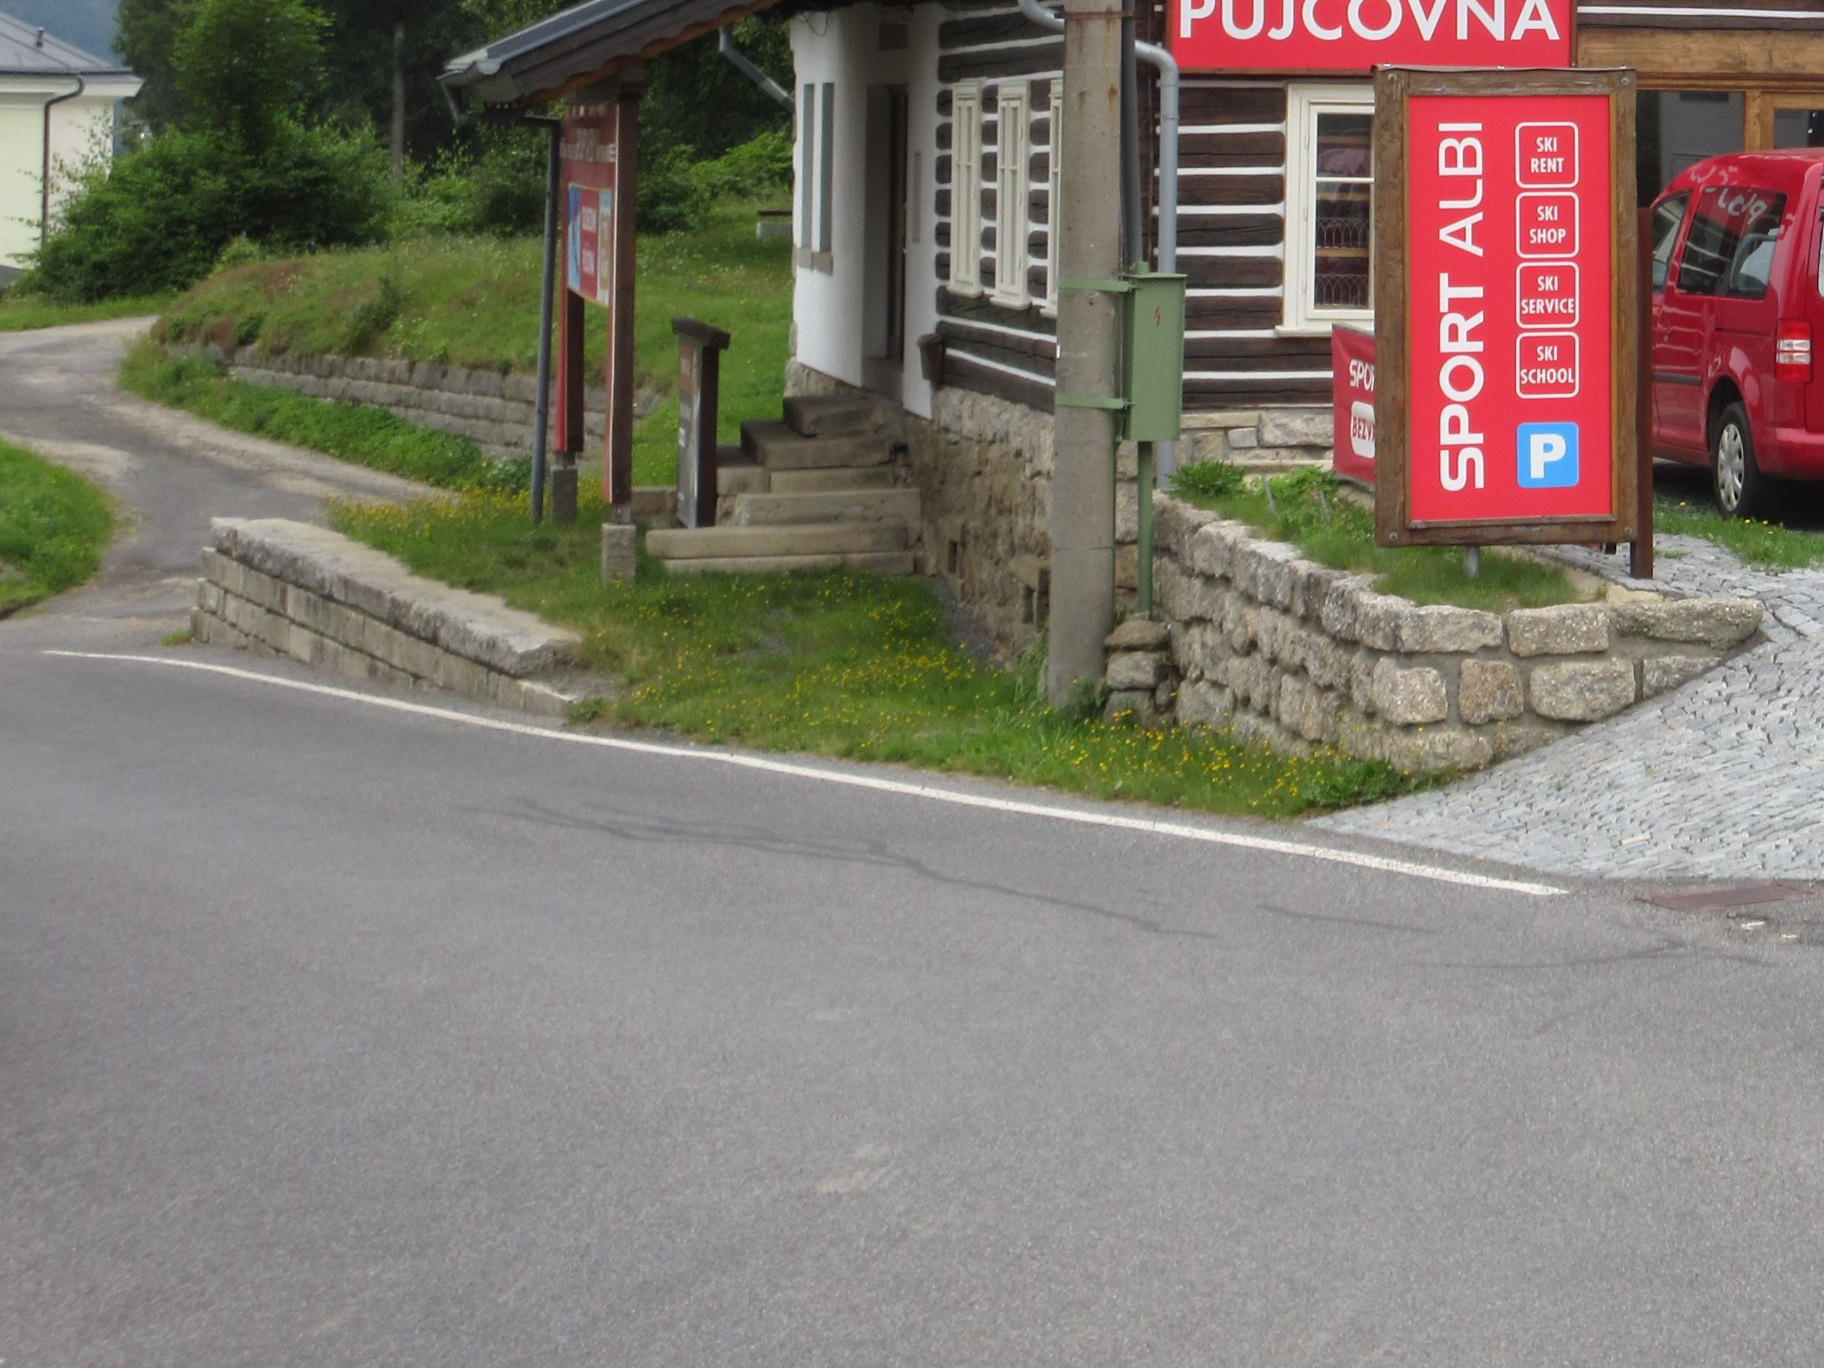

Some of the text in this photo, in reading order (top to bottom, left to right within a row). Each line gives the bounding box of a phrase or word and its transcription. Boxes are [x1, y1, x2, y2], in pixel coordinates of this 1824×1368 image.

[1536, 137, 1558, 152] SKI
[1530, 157, 1565, 173] RENT
[1537, 205, 1558, 221] SKI
[1529, 228, 1567, 244] SHOP
[1537, 275, 1559, 291] SKI
[1438, 122, 1485, 491] SPORT ALBI
[1521, 297, 1575, 314] SERVICE
[1536, 345, 1558, 361] SKI
[1520, 368, 1575, 384] SCHOOL
[1352, 415, 1376, 441] BEZV
[1530, 433, 1567, 479] P
